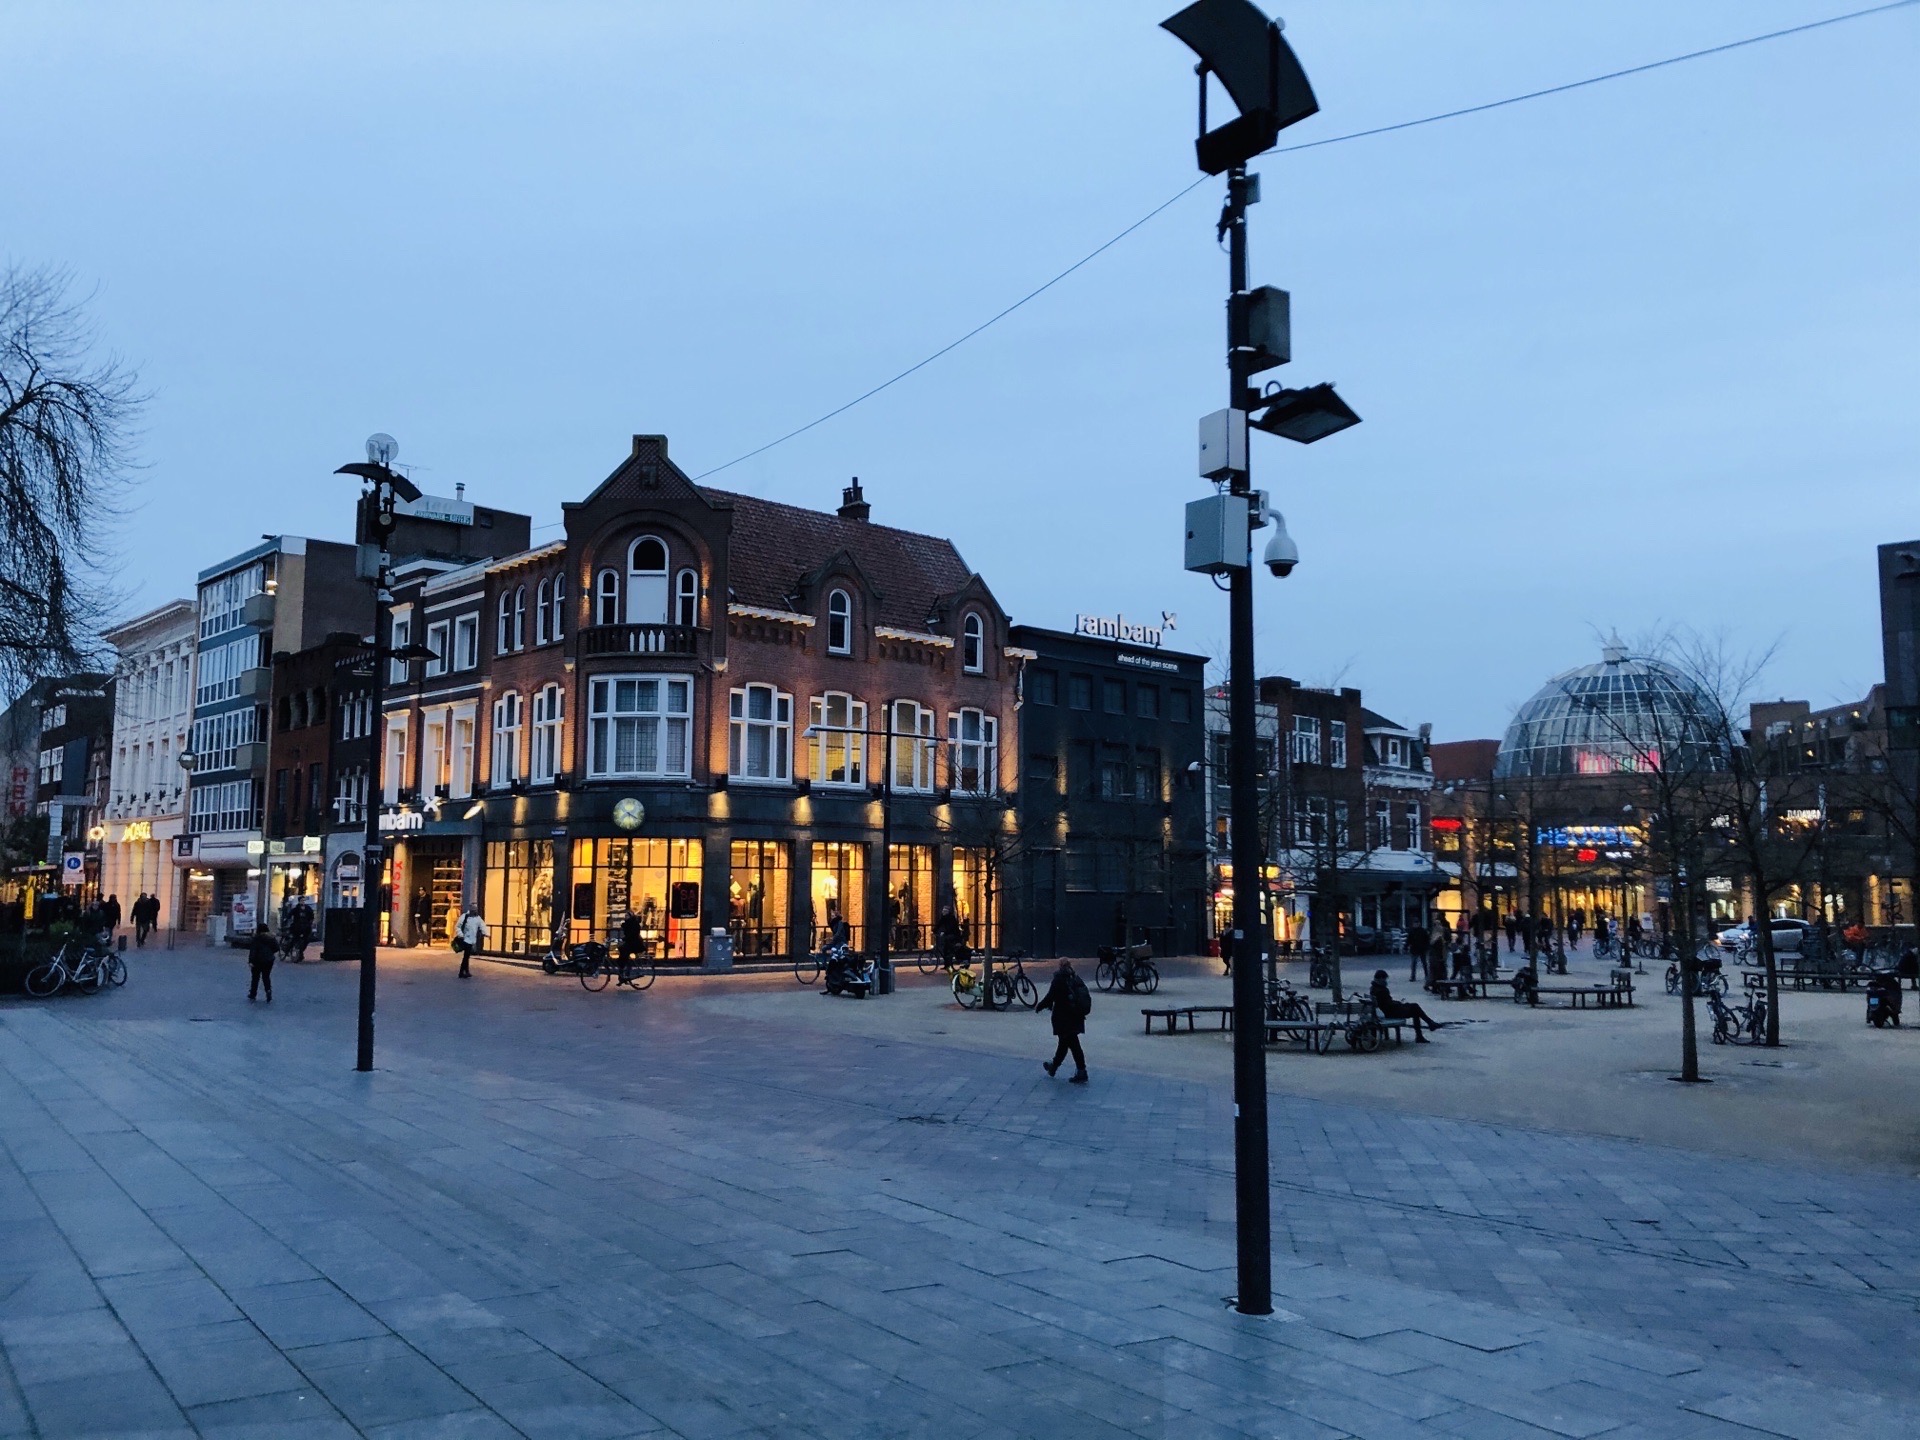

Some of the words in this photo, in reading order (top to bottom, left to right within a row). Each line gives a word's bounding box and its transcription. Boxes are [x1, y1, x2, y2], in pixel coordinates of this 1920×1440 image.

[1076, 613, 1163, 646] rambam
[1117, 654, 1135, 663] ahead
[1135, 656, 1141, 664] of
[1141, 657, 1150, 666] the
[10, 767, 28, 817] HEM
[378, 807, 423, 830] mbam
